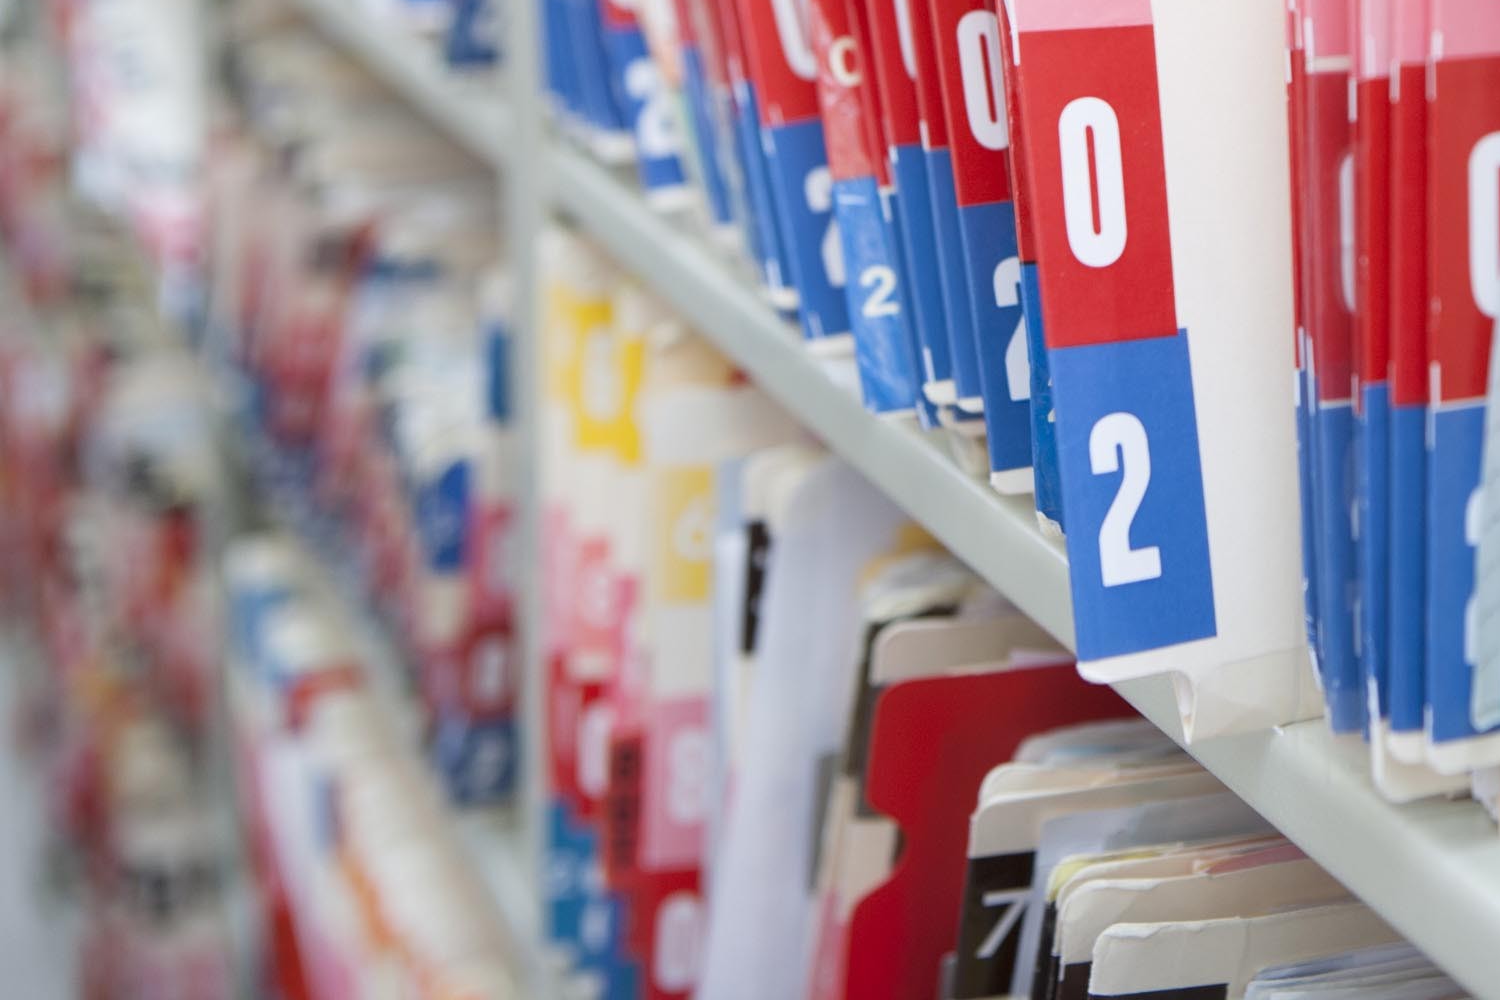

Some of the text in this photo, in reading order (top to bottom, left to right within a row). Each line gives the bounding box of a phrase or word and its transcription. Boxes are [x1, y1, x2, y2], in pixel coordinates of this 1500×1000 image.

[956, 9, 1010, 151] 0
[1058, 96, 1127, 268] 0
[858, 265, 900, 318] 2
[1089, 411, 1162, 587] 2
